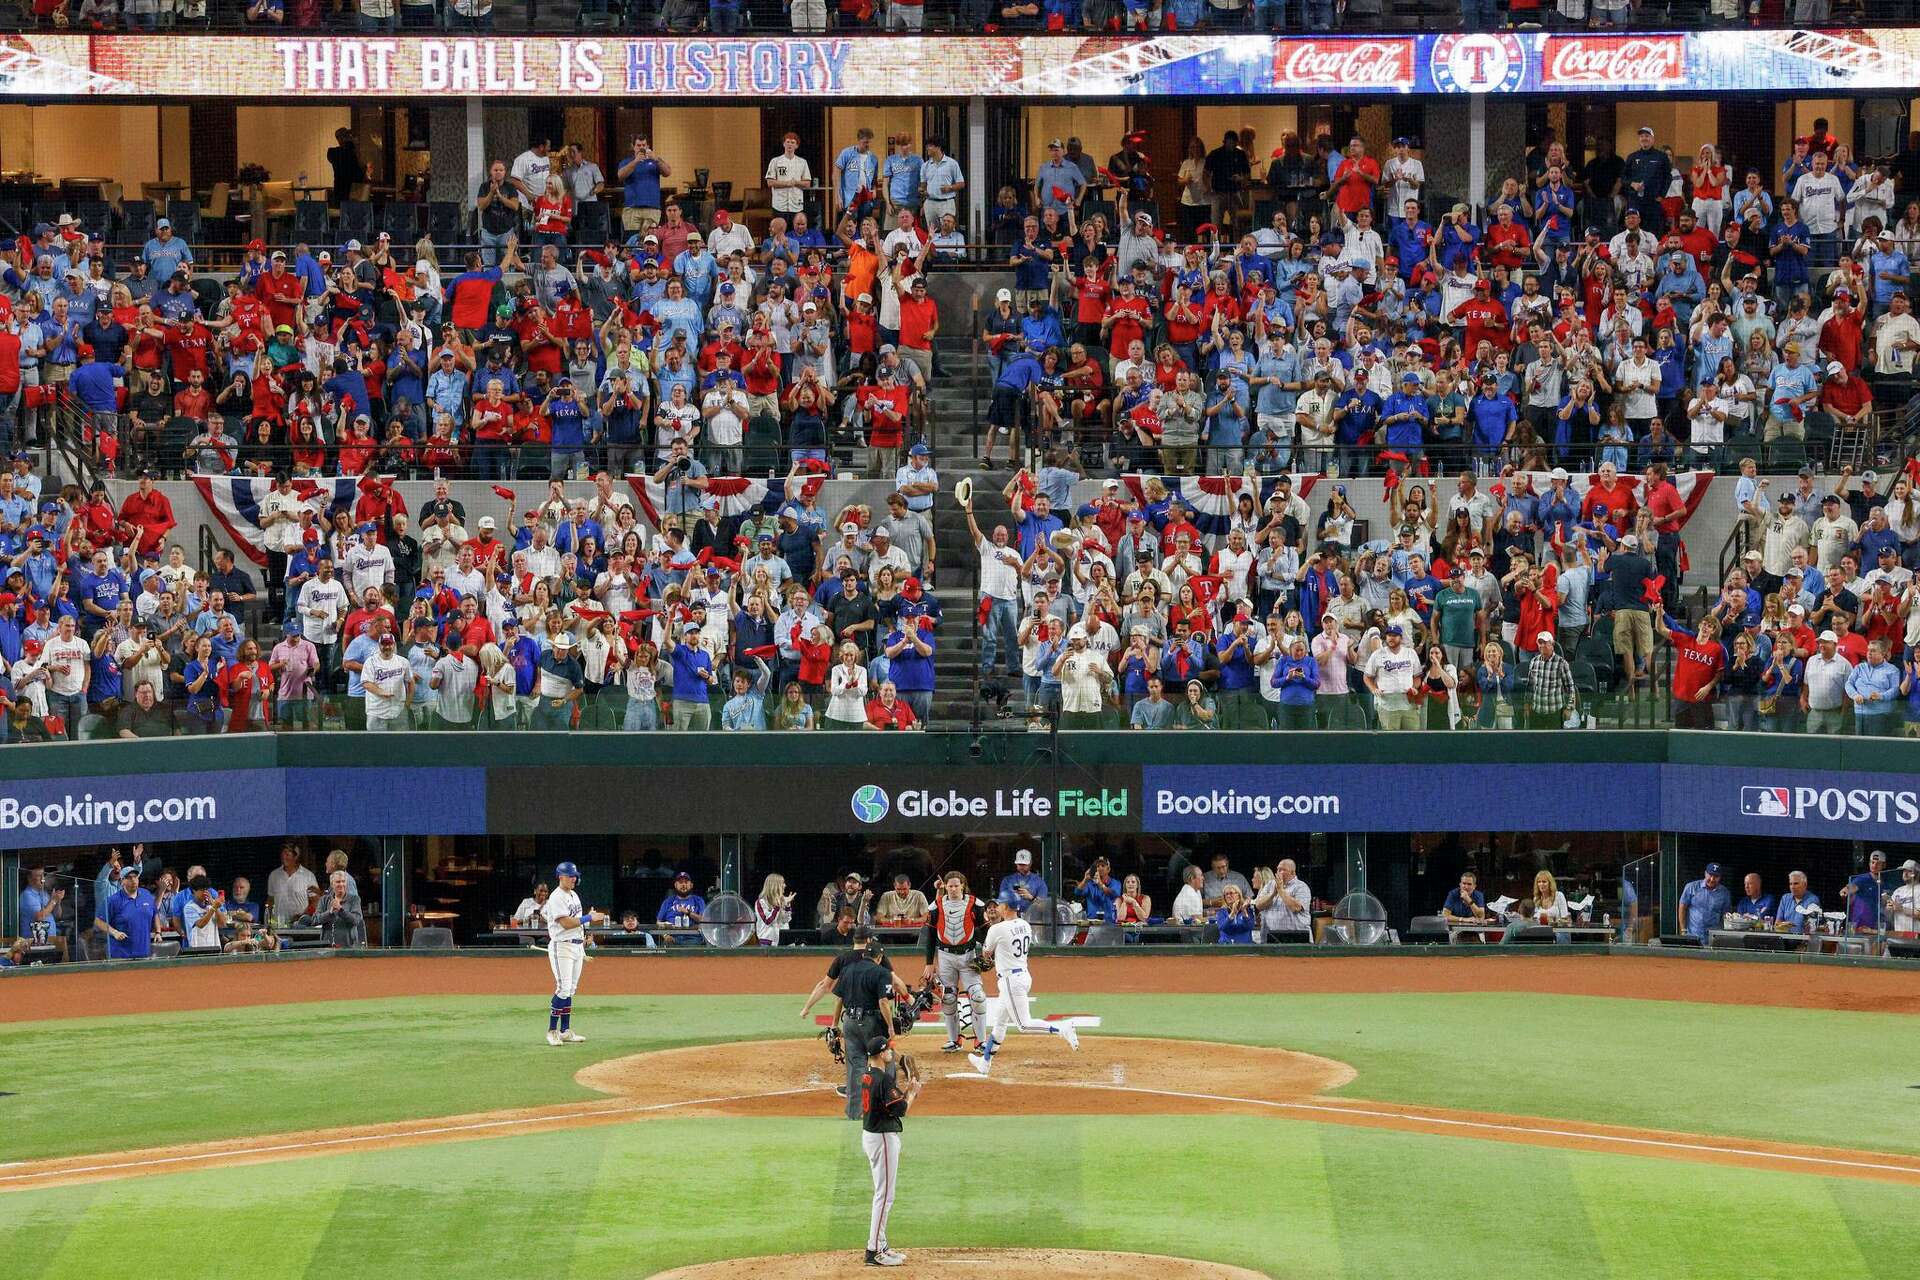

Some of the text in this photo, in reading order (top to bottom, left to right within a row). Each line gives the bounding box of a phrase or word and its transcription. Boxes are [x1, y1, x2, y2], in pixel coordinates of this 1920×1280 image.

[276, 38, 851, 93] THAT BALL IS HISTORY
[1462, 47, 1495, 83] T
[1142, 417, 1160, 427] TEXA
[356, 558, 384, 569] Rangers
[1384, 660, 1410, 672] Rangers
[1684, 648, 1714, 666] TEXAS
[376, 669, 403, 681] Rangers
[0, 793, 217, 832] Booking.com
[897, 788, 1128, 818] Globe Life Field
[1157, 790, 1340, 821] Booking.com
[1795, 787, 1919, 824] POSTS
[1011, 935, 1031, 958] 30
